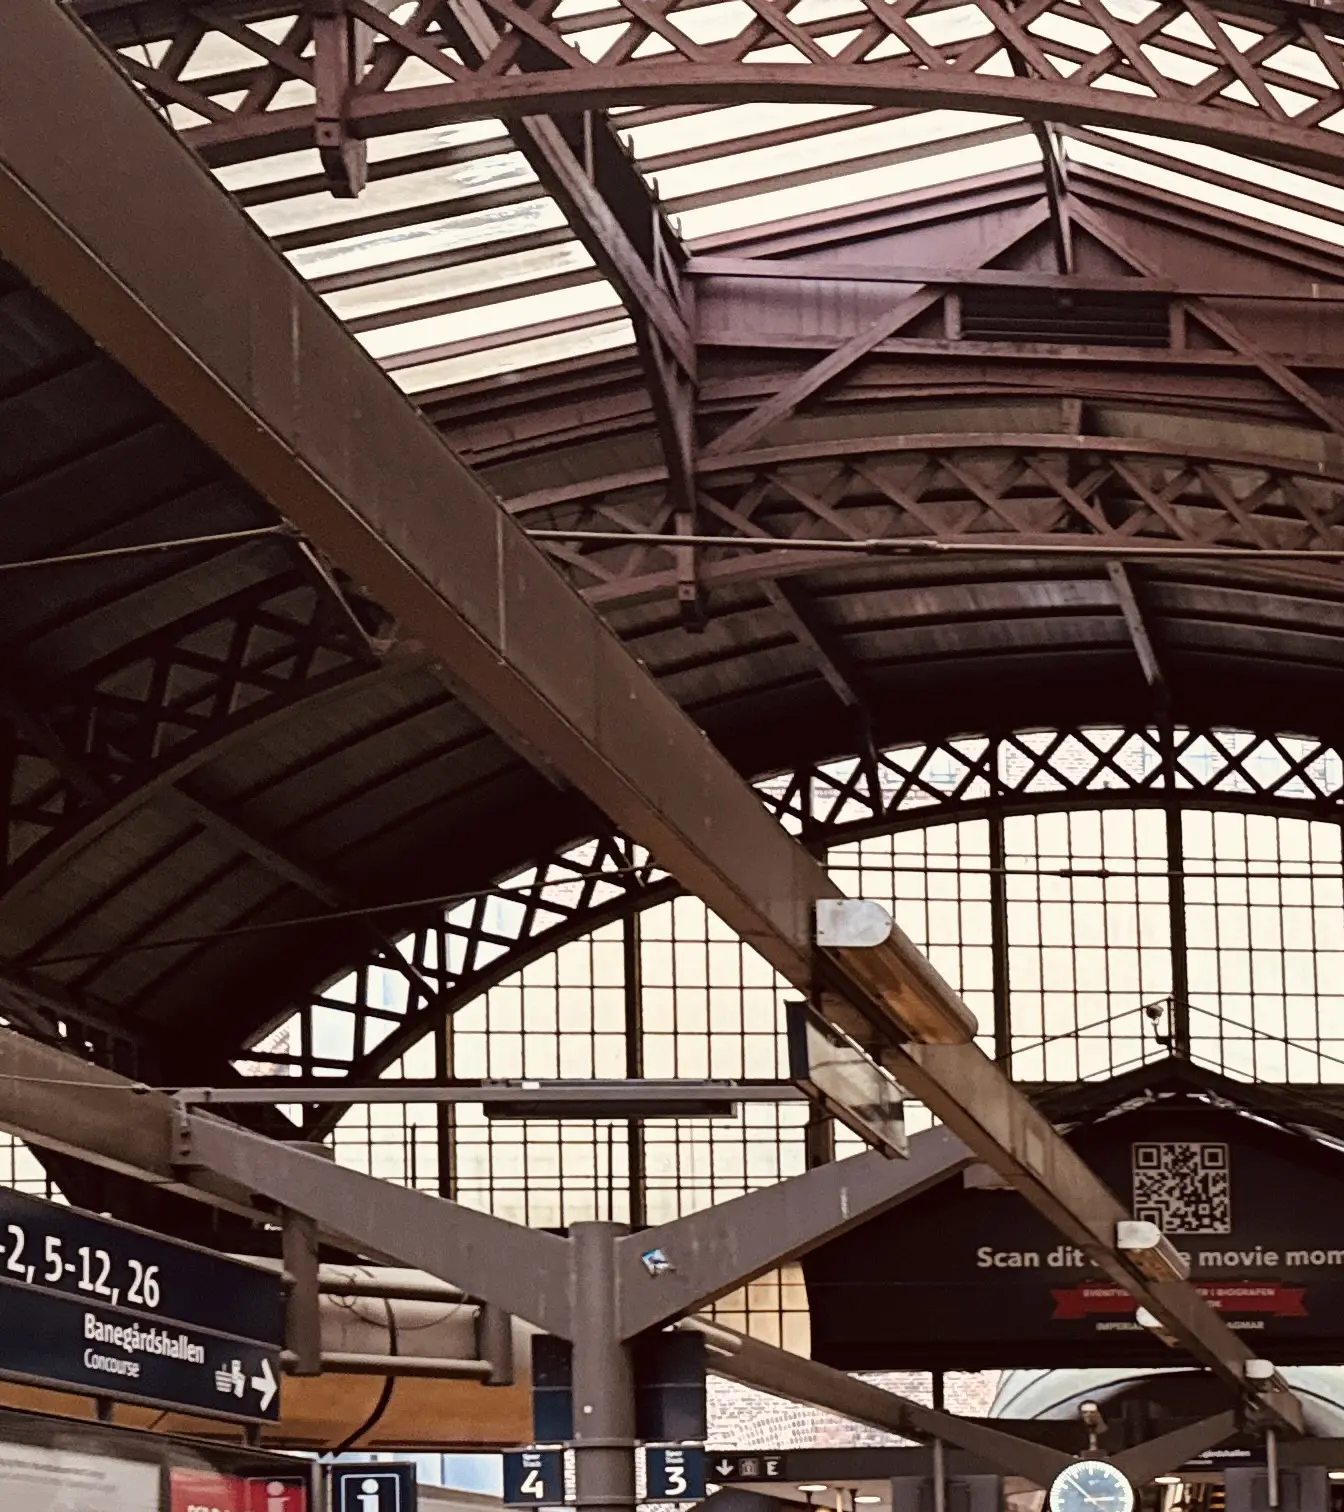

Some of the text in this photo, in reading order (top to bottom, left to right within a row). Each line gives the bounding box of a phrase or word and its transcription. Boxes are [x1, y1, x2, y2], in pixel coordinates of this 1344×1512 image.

[44, 1235, 120, 1306] 5-12,
[127, 1258, 161, 1308] 26
[976, 1247, 1040, 1268] Scan
[1047, 1246, 1085, 1267] dit
[1199, 1246, 1280, 1266] movie
[83, 1312, 205, 1364] Banegårdshallen
[84, 1348, 141, 1378] Concourse
[664, 1466, 687, 1496] 3
[766, 1460, 779, 1476] E
[520, 1469, 544, 1499] 4
